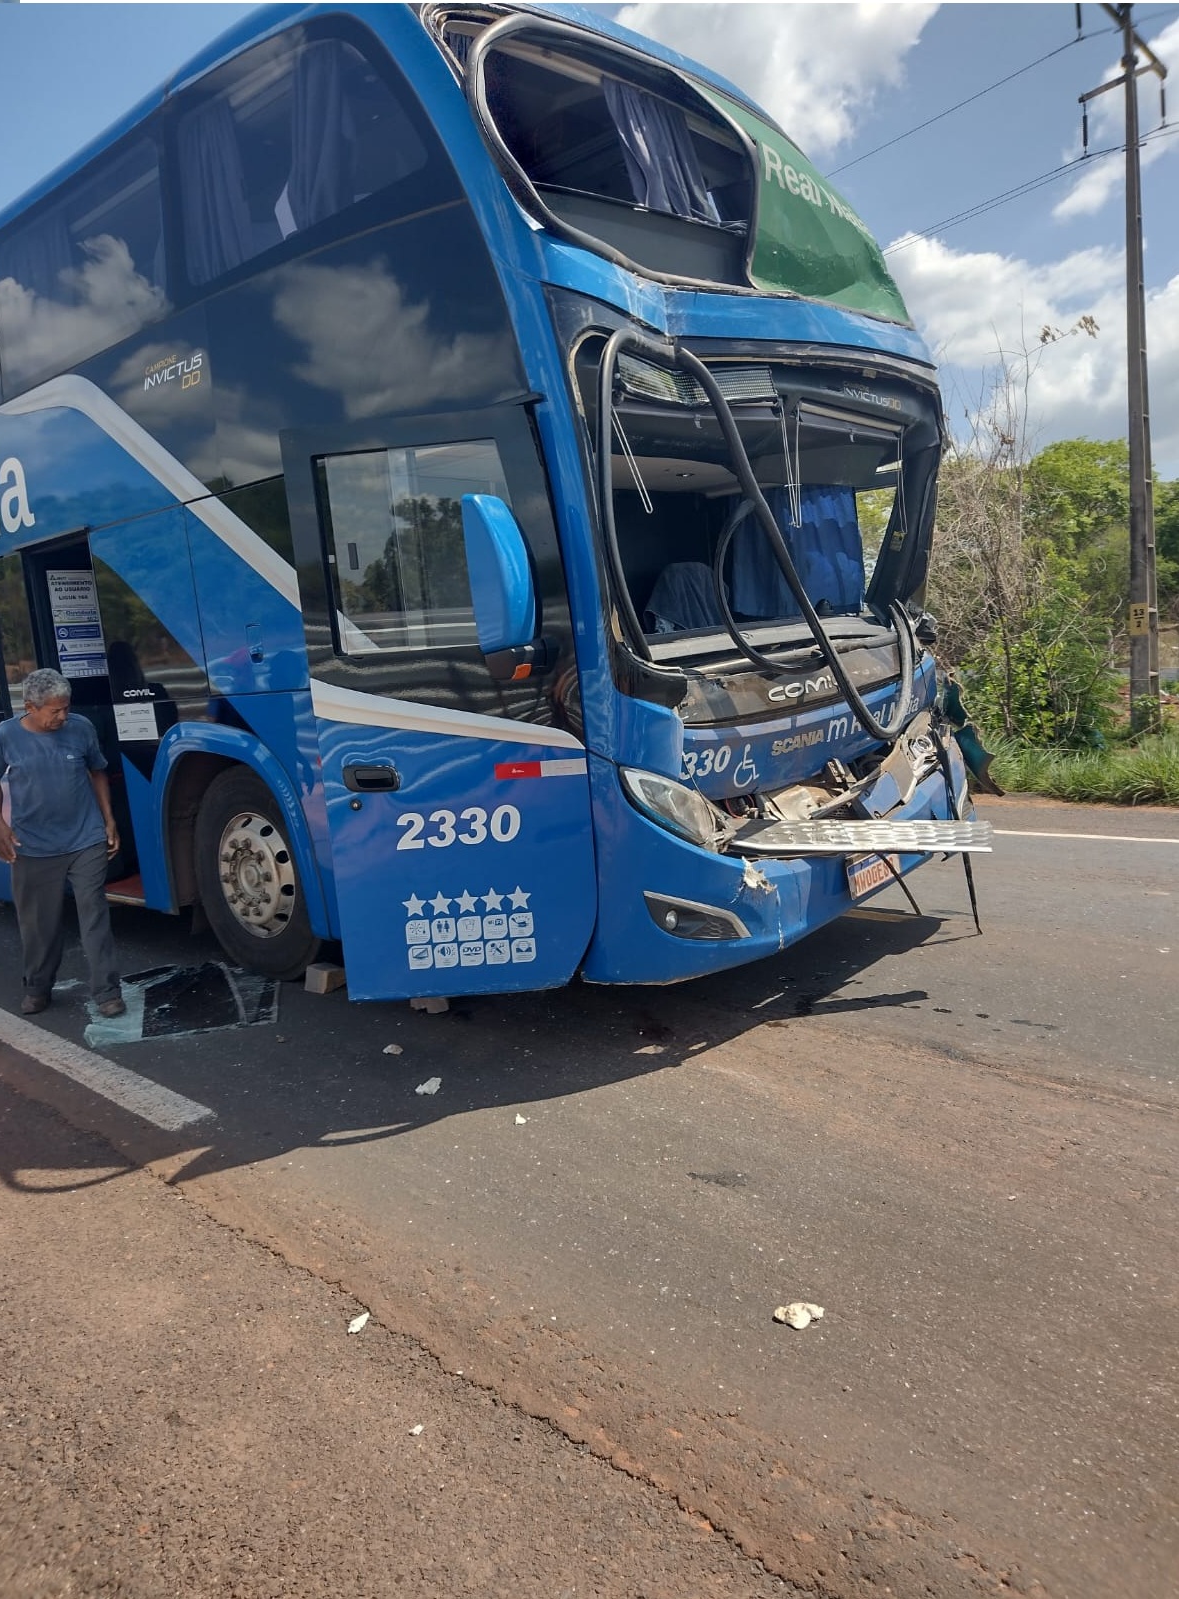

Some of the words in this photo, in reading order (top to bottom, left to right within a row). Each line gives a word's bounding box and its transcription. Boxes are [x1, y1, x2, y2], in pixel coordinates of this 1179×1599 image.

[761, 141, 823, 208] Real
[144, 353, 202, 391] INVICTUS
[182, 371, 201, 389] DD
[123, 688, 156, 698] COMIL
[768, 675, 838, 702] COMI
[771, 729, 825, 756] SCANIA
[396, 804, 521, 851] 2330
